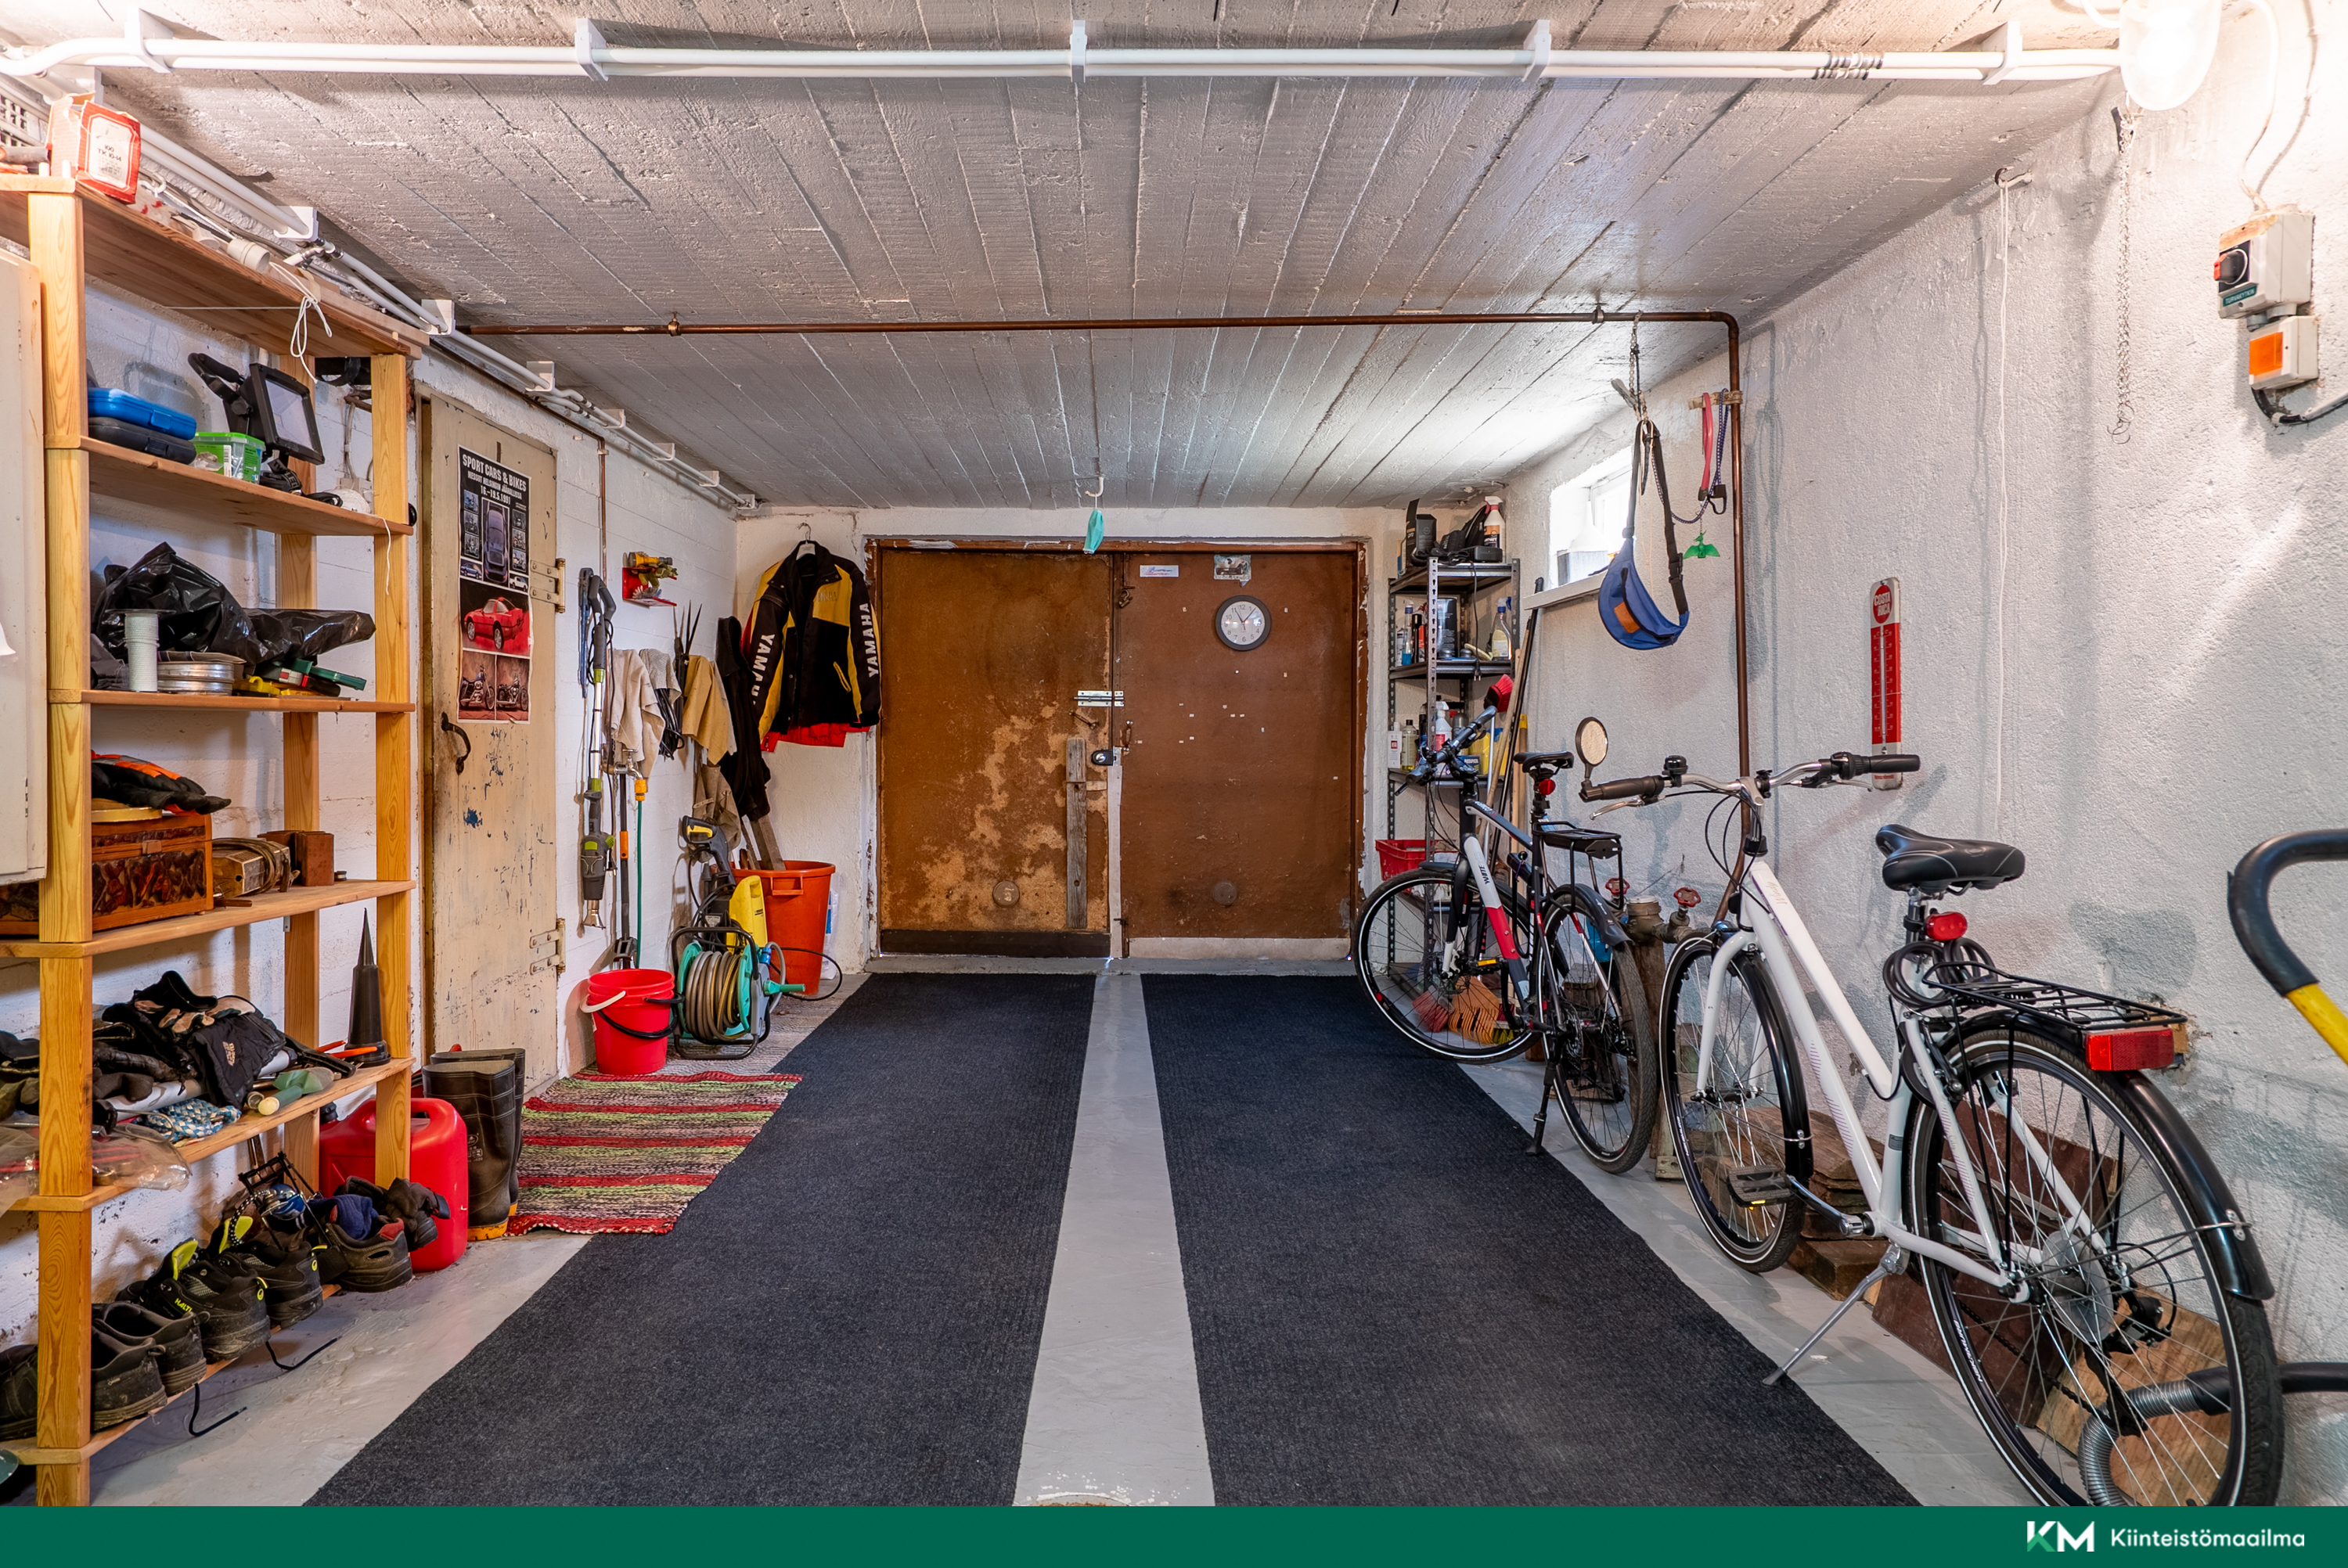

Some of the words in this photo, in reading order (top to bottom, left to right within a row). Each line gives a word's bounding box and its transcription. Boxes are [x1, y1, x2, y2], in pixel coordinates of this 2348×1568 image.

[463, 454, 484, 473] SPORT
[485, 464, 501, 480] CARS
[502, 472, 508, 484] &
[509, 474, 526, 491] BIKES
[1874, 592, 1891, 606] COSTA
[1877, 602, 1891, 617] RICA
[859, 602, 879, 678] YAMAHA
[1478, 865, 1490, 884] WHITE
[174, 1298, 193, 1312] HALTI
[1954, 1319, 1983, 1382] NAKAMURA
